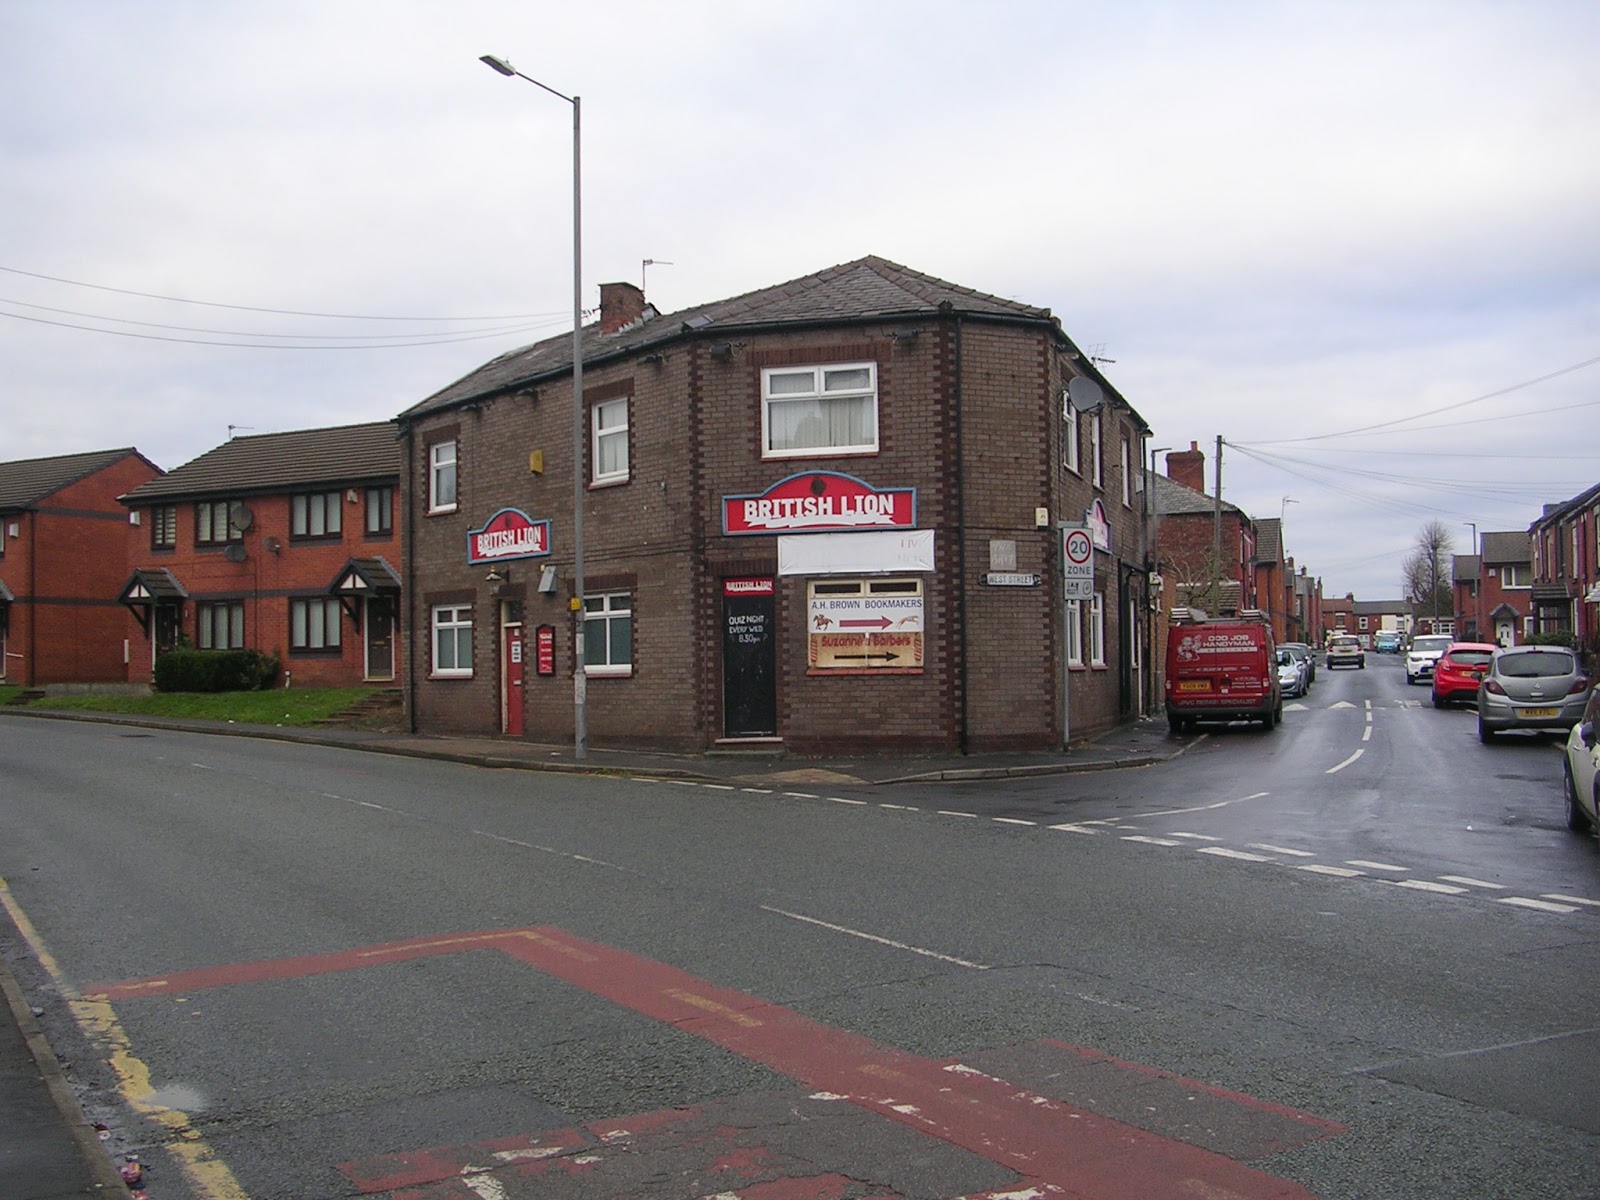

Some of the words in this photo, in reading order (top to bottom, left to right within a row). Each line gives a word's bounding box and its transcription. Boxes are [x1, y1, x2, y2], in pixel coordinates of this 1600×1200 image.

[744, 496, 833, 520] BRITISH
[841, 494, 894, 516] LION
[477, 530, 515, 549] BRITISH
[518, 526, 541, 545] LION
[1070, 541, 1088, 554] 20
[1067, 566, 1091, 574] ZONE
[989, 575, 1006, 583] WEST
[811, 601, 828, 610] A.H.
[830, 600, 860, 609] BROWN
[865, 599, 922, 609] BOOKMAKERS
[728, 615, 746, 625] QUIZ
[729, 626, 748, 634] EVERY
[748, 625, 764, 633] WED
[874, 635, 911, 646] Barbers
